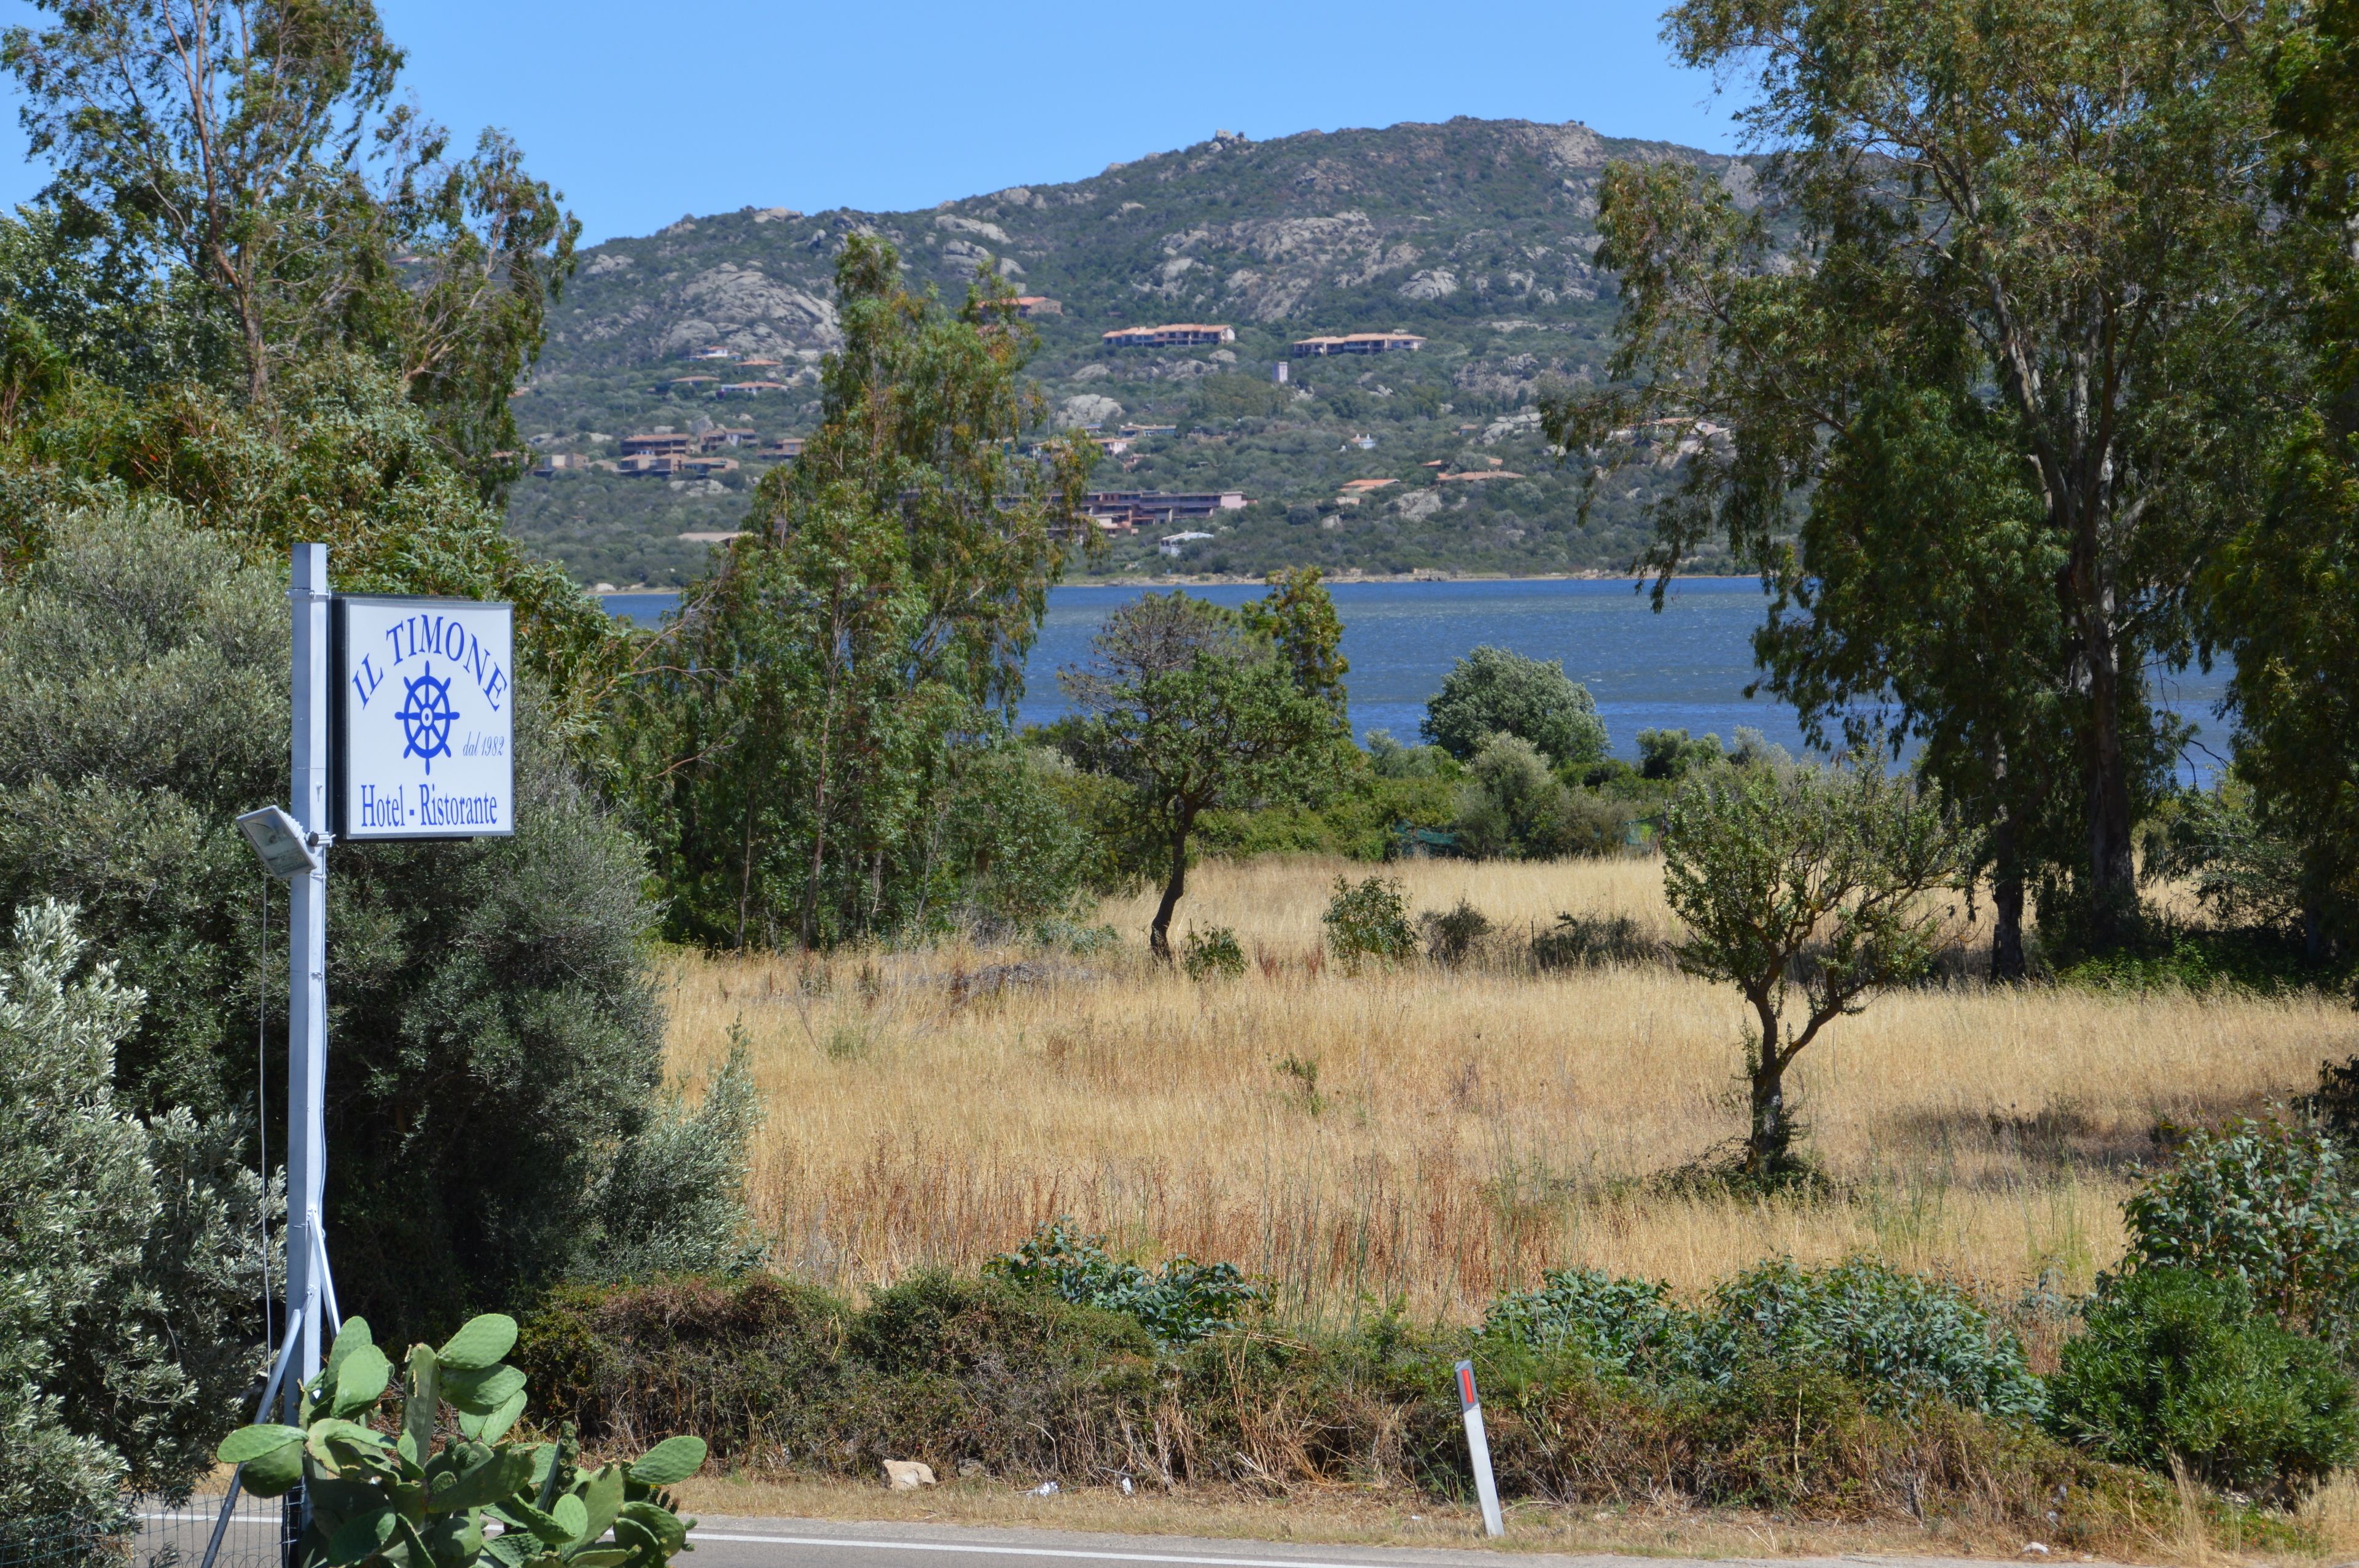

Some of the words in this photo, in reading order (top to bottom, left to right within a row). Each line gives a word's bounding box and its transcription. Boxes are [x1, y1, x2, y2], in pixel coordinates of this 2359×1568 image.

[351, 653, 384, 710] IL
[386, 614, 507, 712] TIMONE
[463, 731, 480, 757] dal
[481, 736, 504, 756] 1982
[361, 784, 405, 827] Hotel
[419, 783, 497, 825] Ristorante
